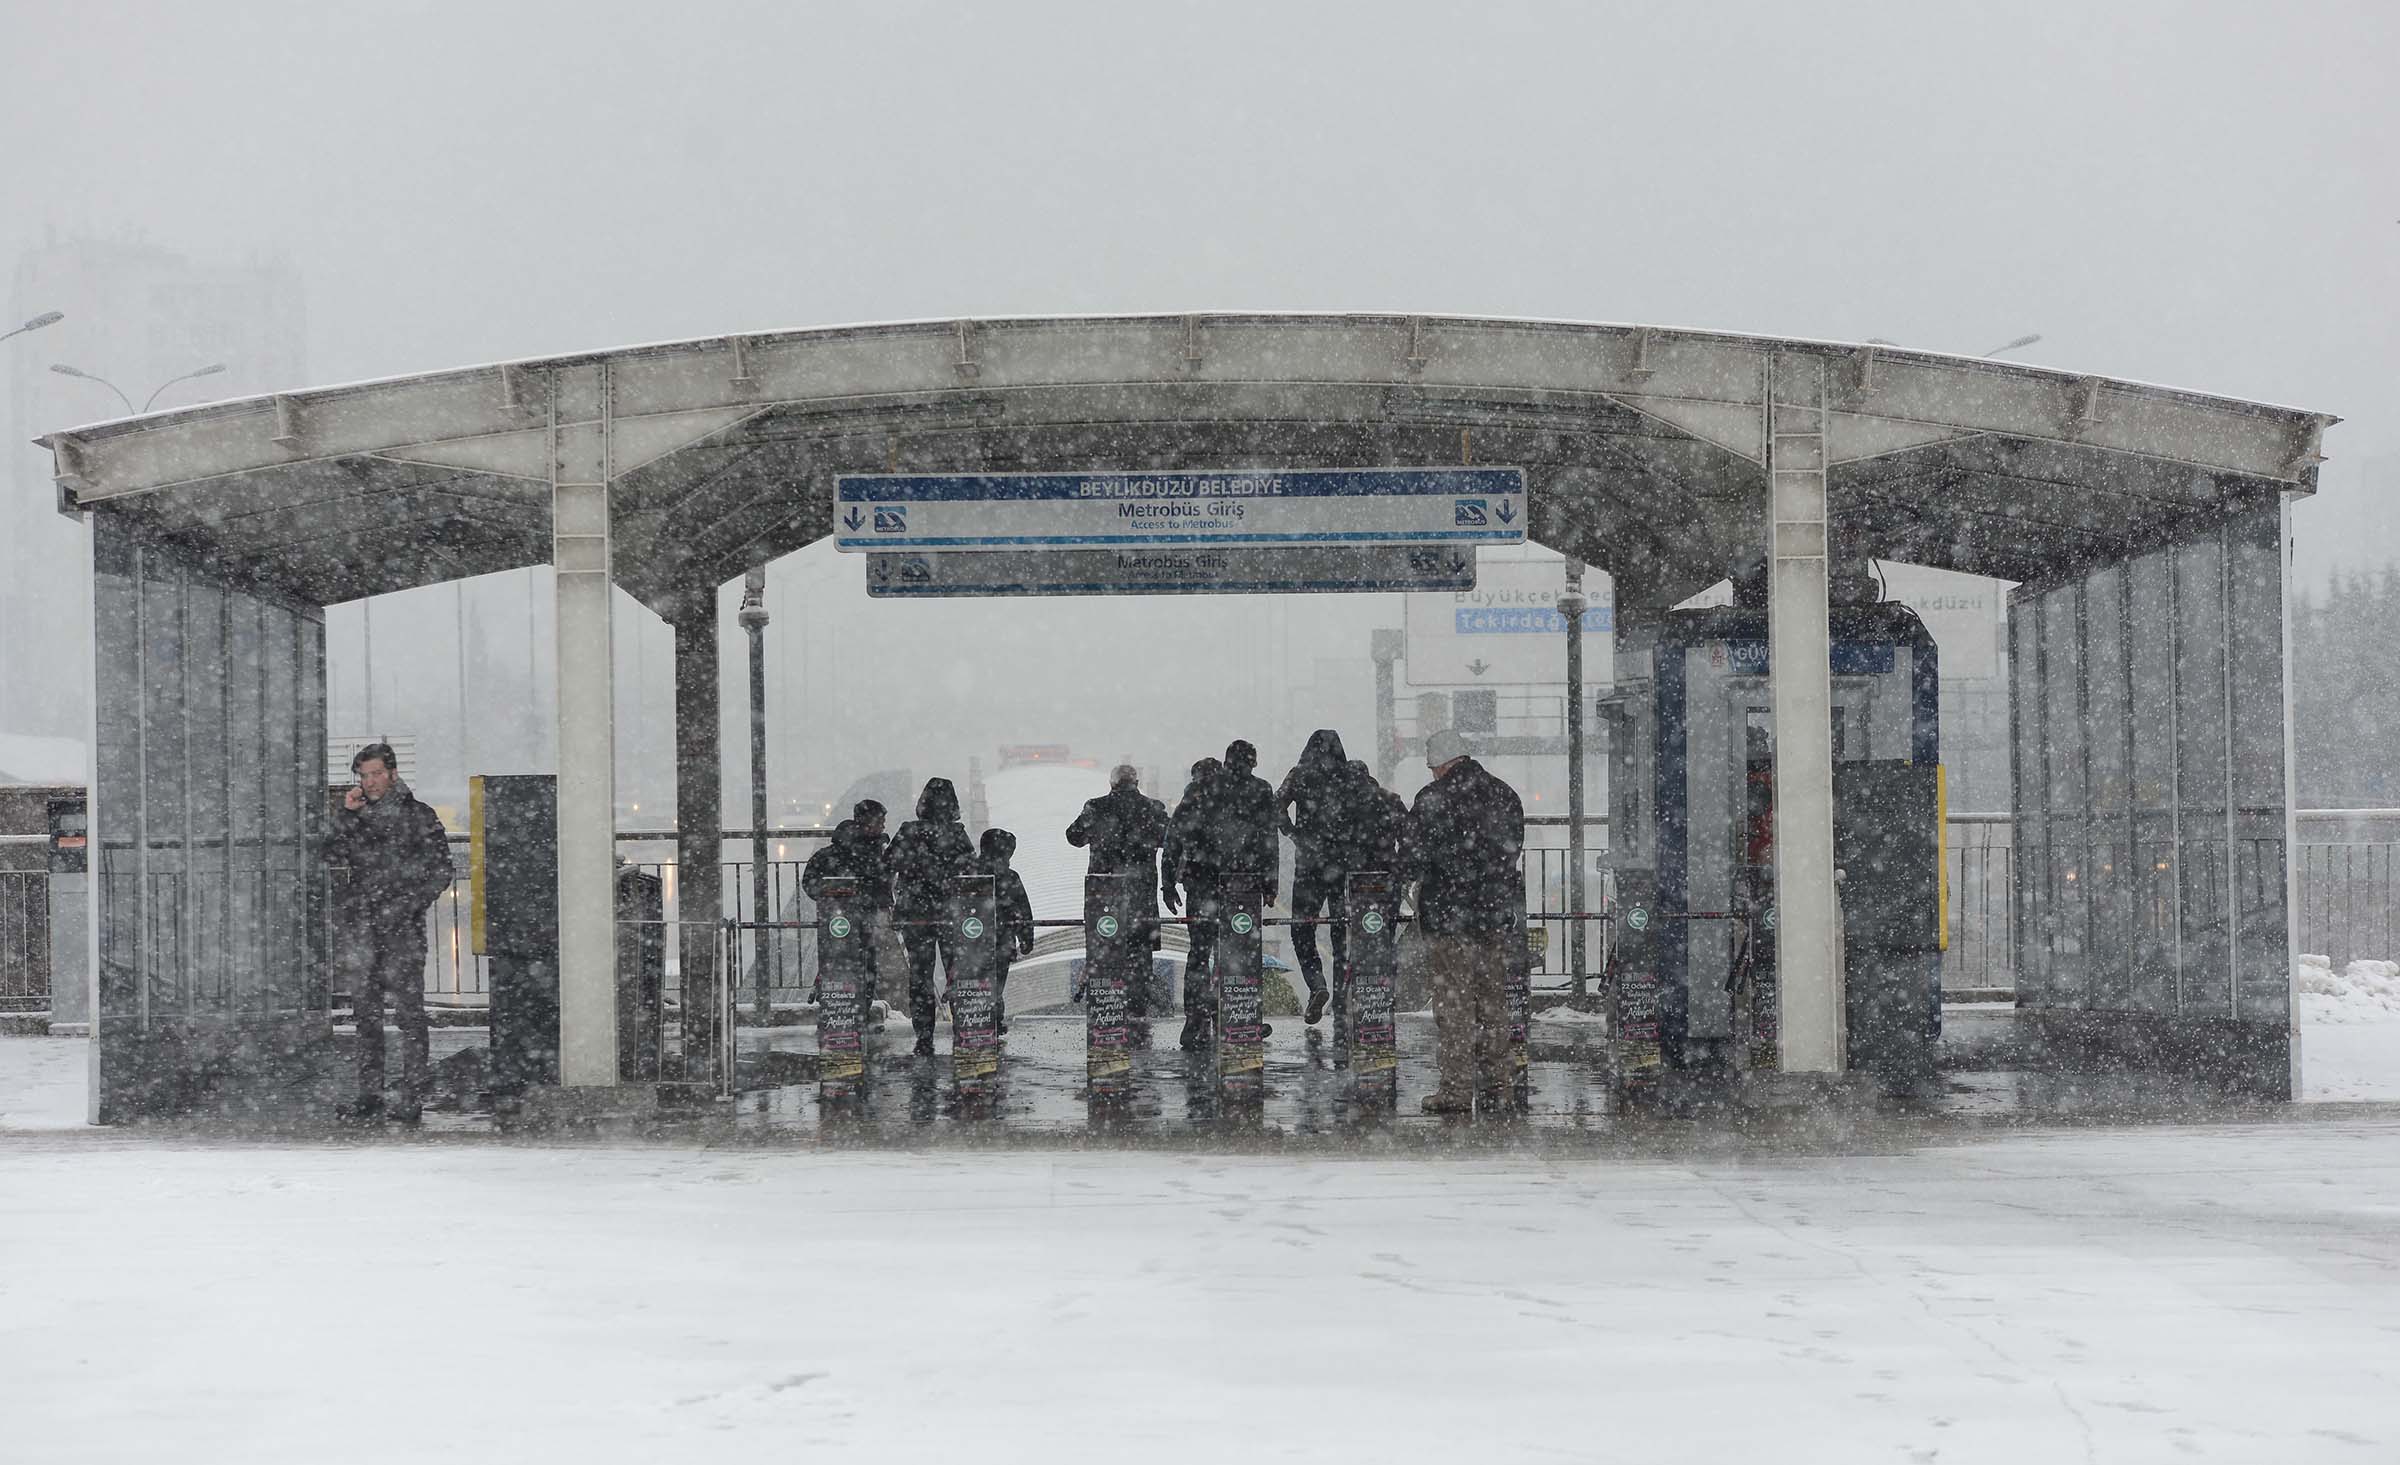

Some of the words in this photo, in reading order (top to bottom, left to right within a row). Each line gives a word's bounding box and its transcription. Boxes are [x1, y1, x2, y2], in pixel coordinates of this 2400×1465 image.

[1080, 477, 1194, 497] BEYLİKDÜZÜ
[1199, 477, 1283, 496] BELEDİYE
[1118, 501, 1201, 518] Metrobüs
[1206, 500, 1245, 519] Giriş
[1131, 519, 1165, 529] Access
[1168, 520, 1180, 529] to
[1183, 518, 1235, 529] Metrobus
[1117, 555, 1190, 569] Metrobüs
[1196, 554, 1230, 571] Giriş
[1461, 612, 1560, 632] Tekirdağ
